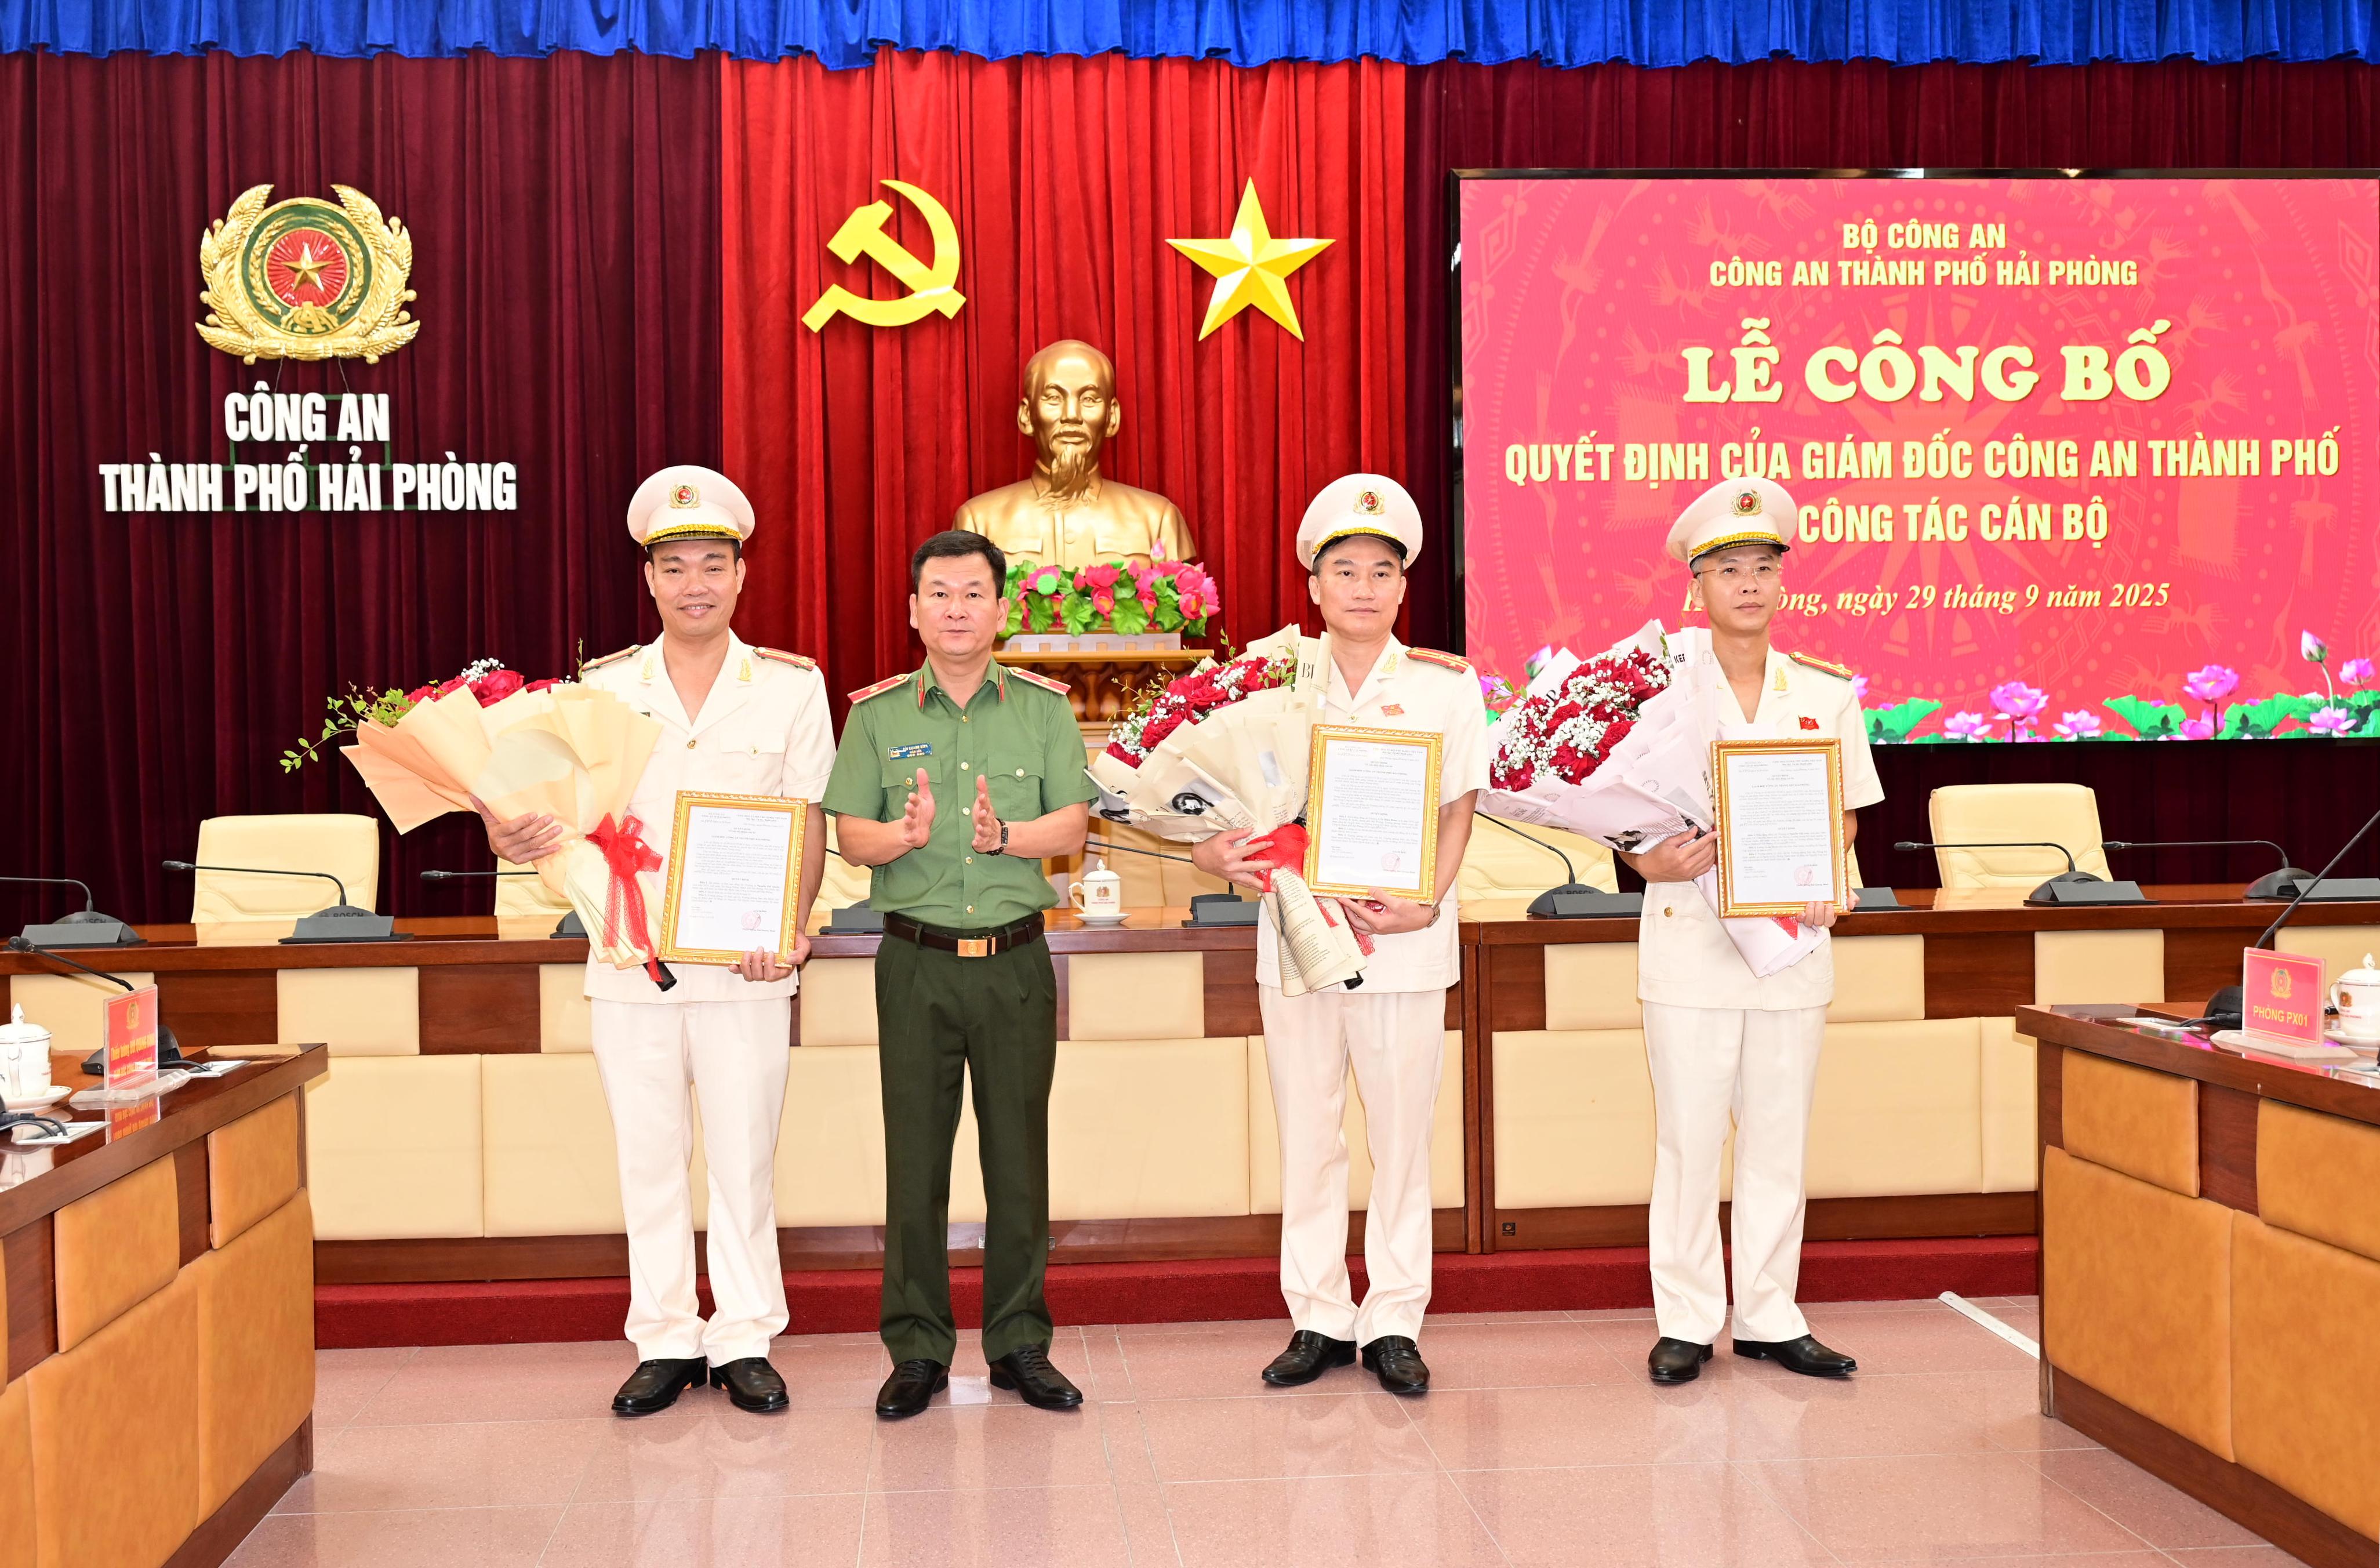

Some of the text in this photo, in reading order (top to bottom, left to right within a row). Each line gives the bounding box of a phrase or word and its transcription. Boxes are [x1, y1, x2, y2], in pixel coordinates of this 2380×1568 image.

[1844, 219, 2006, 252] BỘ CÔNG AN
[1710, 252, 2138, 287] CÔNG AN THÀNH PHỐ HẢI PHÒNG
[1682, 318, 2172, 404] LỄ CÔNG BỐ
[224, 381, 390, 442] CÔNG AN
[99, 444, 517, 512] THÀNH PHỐ HẢI PHÒNG
[1506, 426, 2341, 491] QUYẾT ĐỊNH CỦA GIÁM ĐỐC CÔNG AN THÀNH PHỐ
[1798, 495, 2108, 549] CÔNG TÁC CÁN BỘ
[1837, 585, 1899, 616] ngày
[1906, 585, 1936, 609] 29
[1943, 584, 2017, 615] tháng
[2025, 584, 2040, 608] 9
[2047, 585, 2102, 608] năm
[2109, 583, 2170, 608] 2025
[2253, 1004, 2308, 1027] PHÒNG PX01
